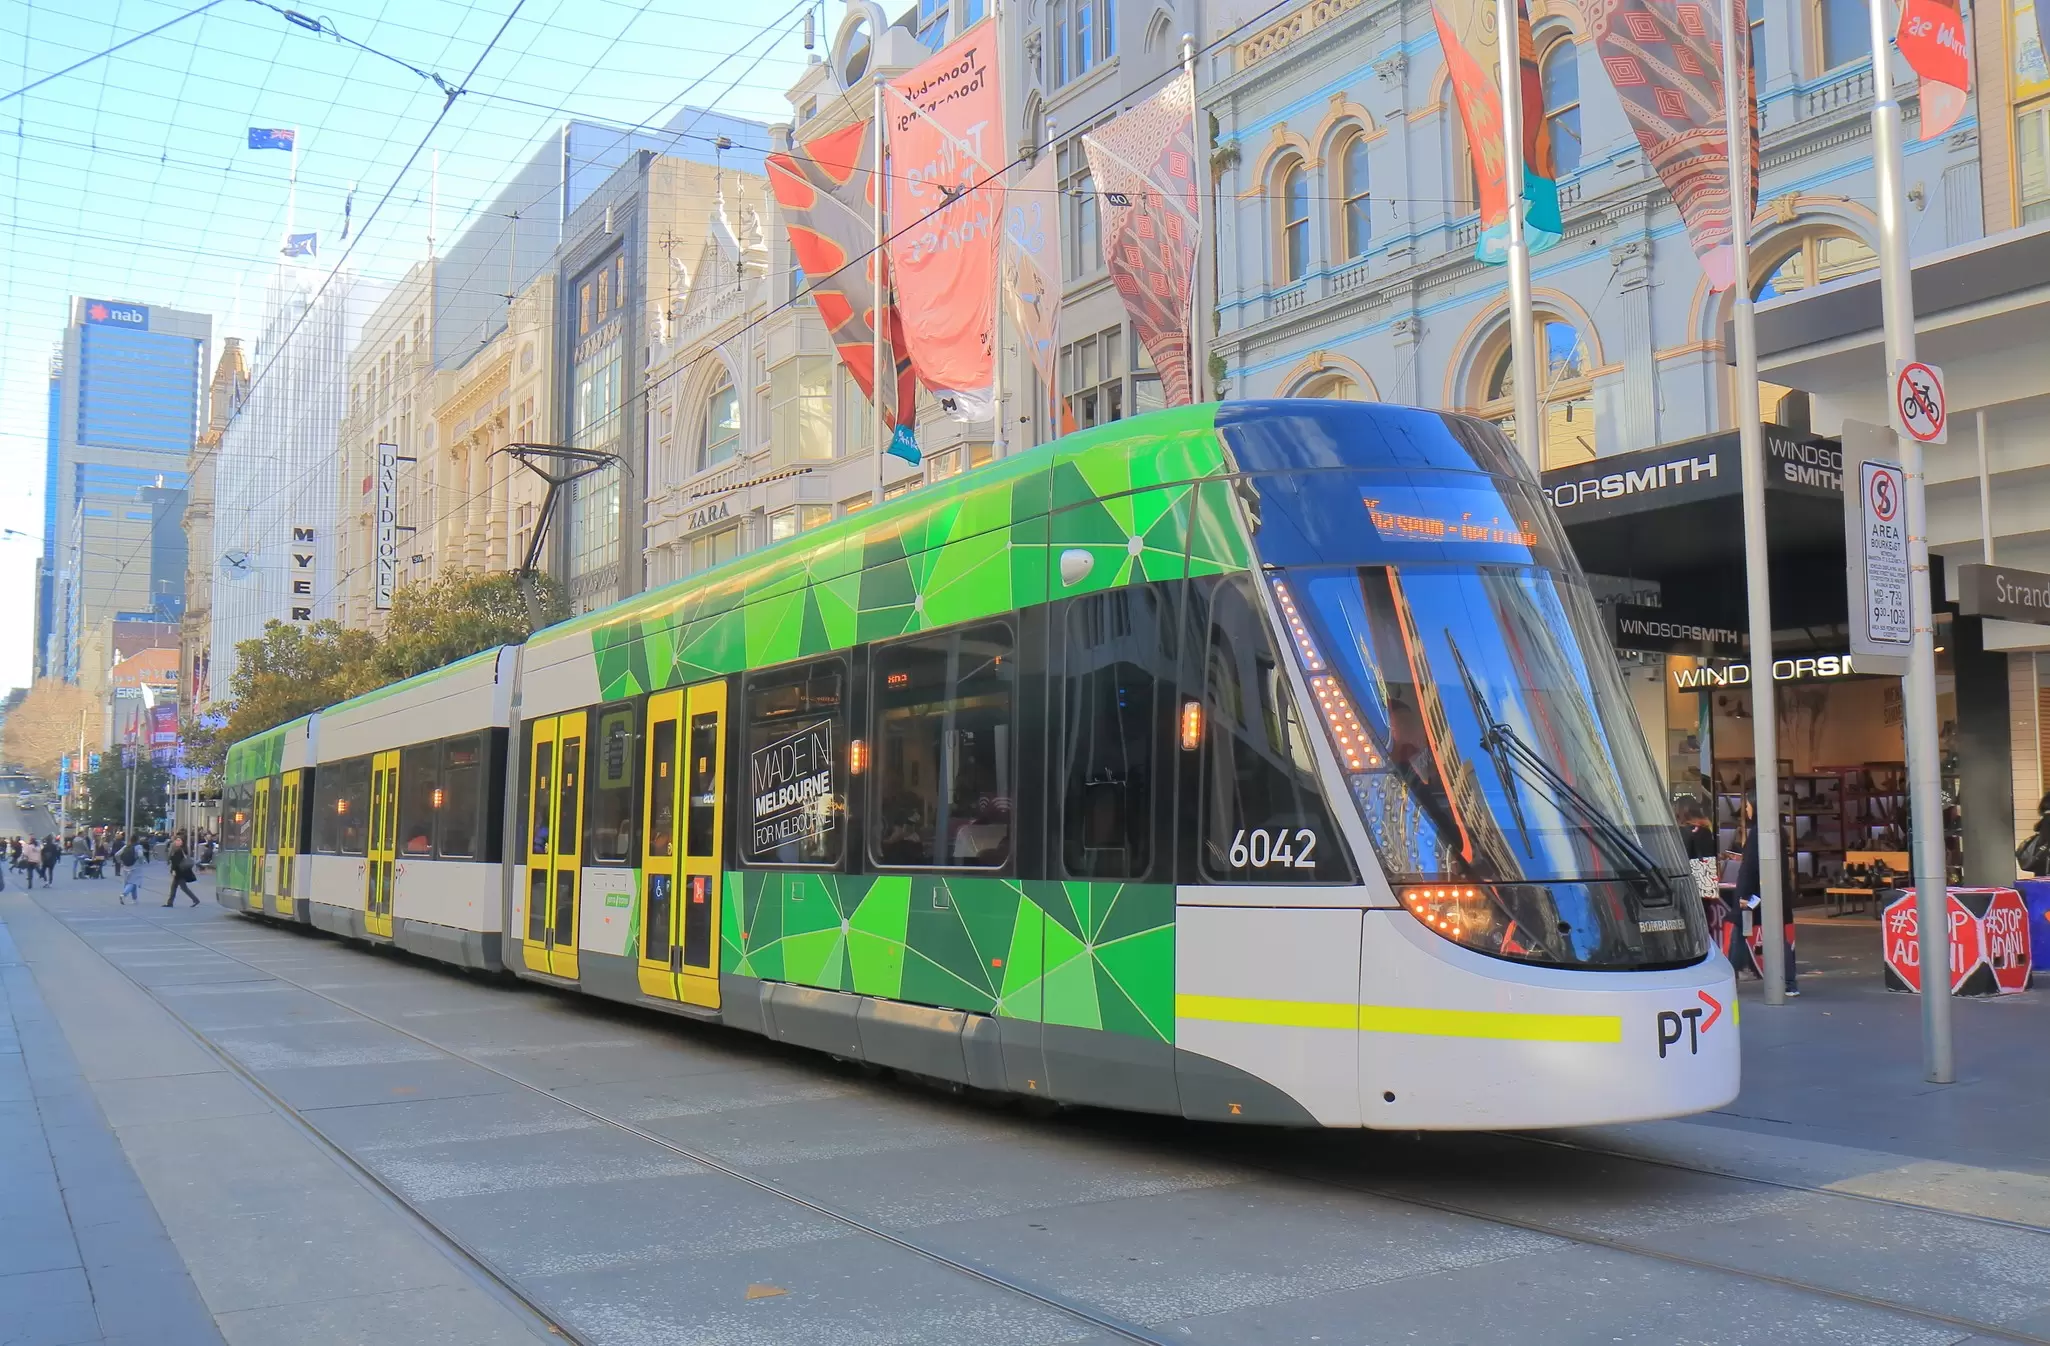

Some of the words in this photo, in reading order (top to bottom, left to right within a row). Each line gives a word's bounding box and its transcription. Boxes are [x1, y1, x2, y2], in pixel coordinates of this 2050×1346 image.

[1110, 194, 1127, 205] 40
[111, 304, 143, 323] nab
[1769, 436, 1842, 471] WINDSO
[381, 453, 395, 523] DAVID
[1784, 462, 1843, 492] SMITH
[687, 501, 730, 531] ZARA
[1872, 523, 1899, 540] AREA
[292, 527, 314, 621] MYER
[380, 528, 394, 602] JONES
[1996, 574, 2050, 608] Strand
[1620, 618, 1737, 645] WINDSORSMITH
[1674, 655, 1856, 688] WINDORS
[754, 737, 807, 793] MADE
[811, 727, 829, 770] IN
[755, 771, 829, 817] MELBOURNE
[756, 824, 774, 847] FOR
[775, 810, 831, 838] MELBOURNE
[1229, 828, 1316, 868] 6042
[1890, 908, 1968, 941] #SP
[1986, 908, 2022, 936] #STOP
[1892, 939, 1964, 974] ADI
[1991, 931, 2024, 969] ADANI
